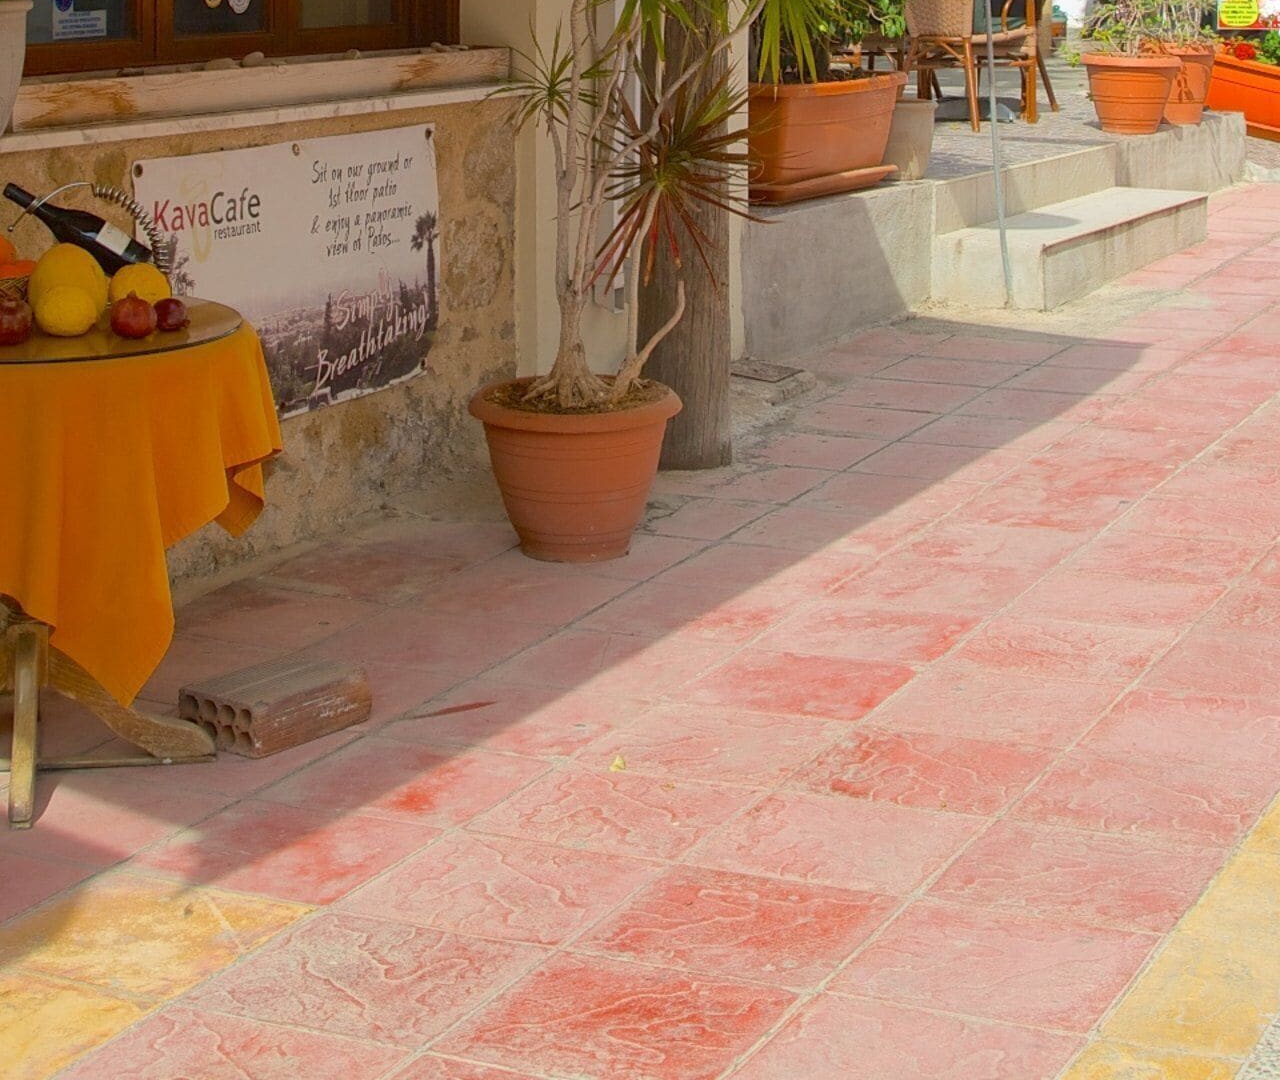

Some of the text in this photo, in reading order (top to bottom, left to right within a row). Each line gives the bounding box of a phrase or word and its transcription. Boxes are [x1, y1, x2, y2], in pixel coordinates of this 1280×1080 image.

[312, 152, 413, 186] Sit on our ground or
[345, 181, 368, 207] floor
[372, 177, 397, 207] patio
[214, 220, 261, 241] restaurant
[325, 214, 350, 242] enjoy
[354, 214, 361, 226] a
[365, 201, 412, 233] panoramic
[326, 239, 348, 257] view
[353, 228, 362, 250] of
[336, 267, 394, 330] Simply
